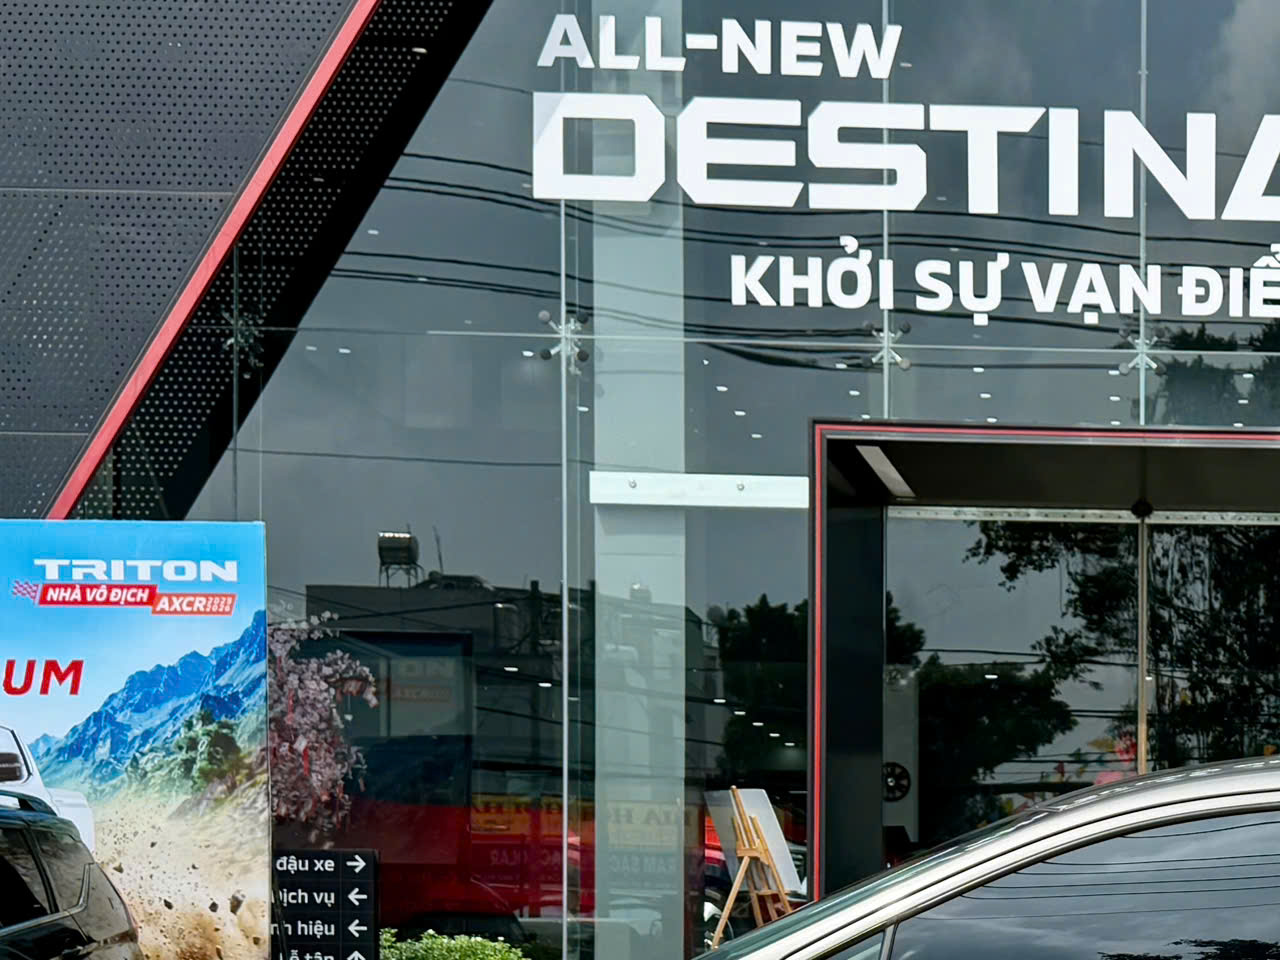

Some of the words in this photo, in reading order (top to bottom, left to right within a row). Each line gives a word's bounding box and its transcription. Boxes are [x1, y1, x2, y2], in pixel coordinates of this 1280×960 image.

[536, 13, 903, 79] ALL-NEW
[730, 234, 895, 311] KHỞI
[914, 252, 1009, 326] SỰ
[1021, 262, 1162, 325] VẠN
[33, 558, 239, 582] TRITON
[46, 585, 81, 602] NHÀ
[86, 585, 107, 602] VÔ
[110, 587, 149, 605] ĐỊCH
[156, 597, 206, 612] AXCR
[276, 856, 309, 874] đậu
[314, 859, 335, 872] xe
[313, 892, 335, 907] vụ
[297, 920, 335, 939] hiệu
